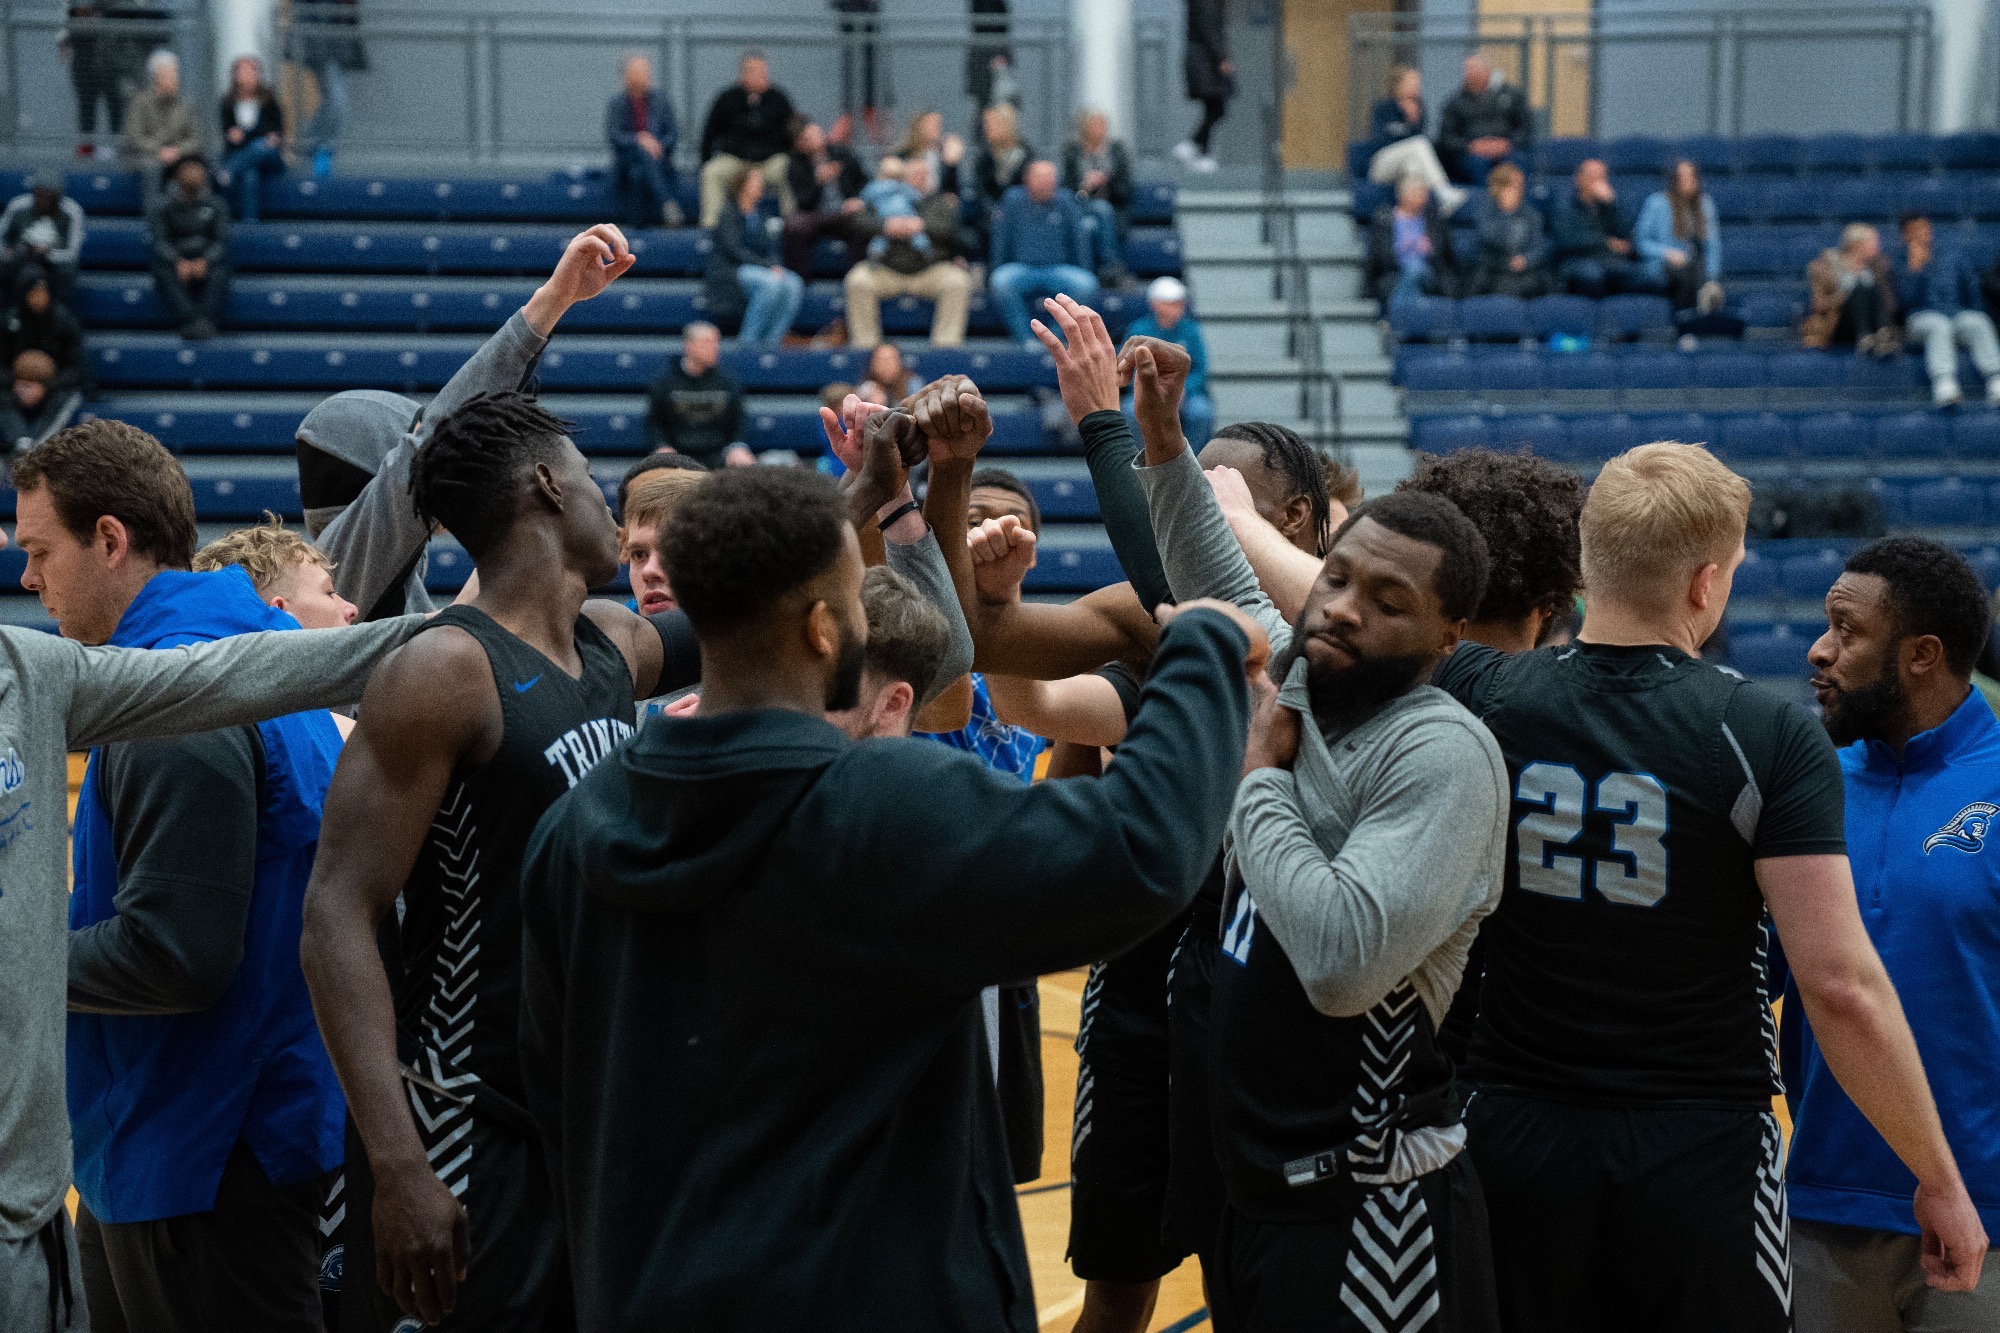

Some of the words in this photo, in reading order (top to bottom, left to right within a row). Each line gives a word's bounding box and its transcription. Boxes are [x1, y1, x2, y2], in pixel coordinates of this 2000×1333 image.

[543, 717, 636, 789] TRINIT
[1515, 759, 1671, 908] 23
[1320, 1160, 1328, 1172] L
